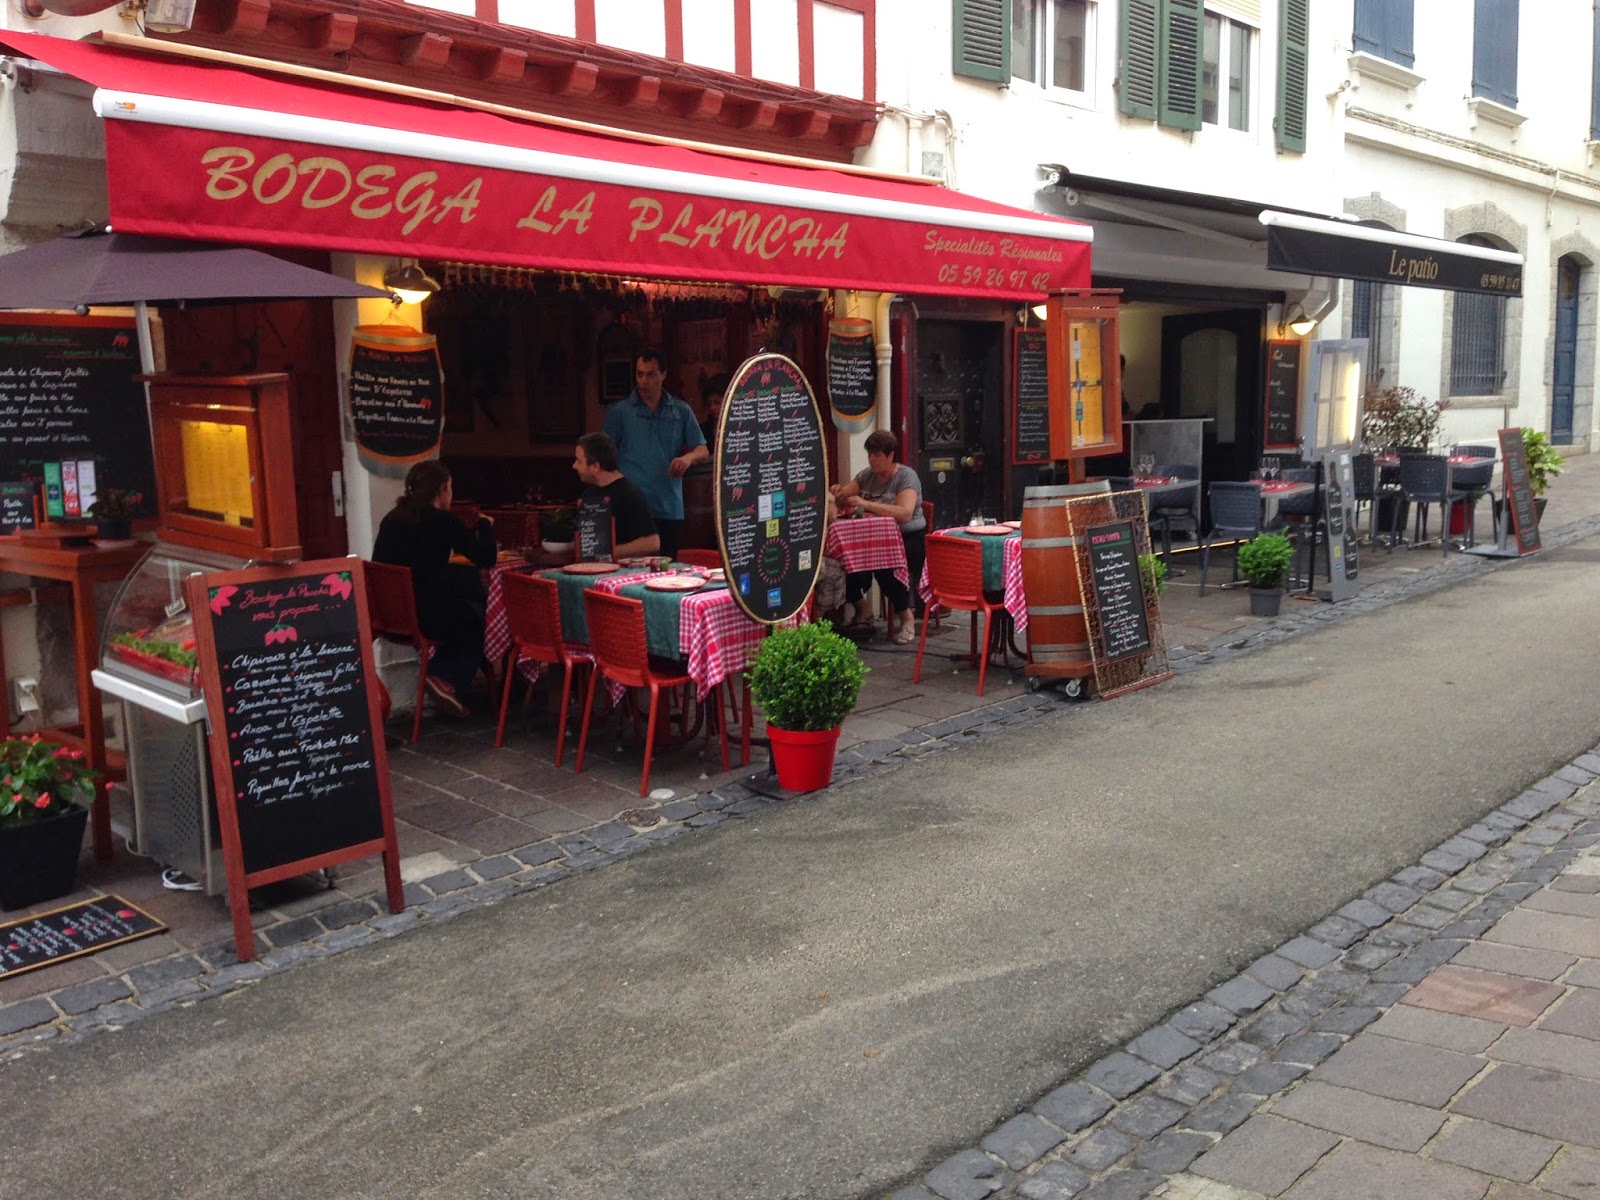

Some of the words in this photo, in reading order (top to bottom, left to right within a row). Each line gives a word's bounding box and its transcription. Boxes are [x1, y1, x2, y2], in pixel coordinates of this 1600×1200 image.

[201, 146, 482, 235] BODEGA
[516, 185, 597, 235] LA
[627, 197, 850, 260] PLANCHA
[999, 238, 1064, 265] Régionales
[938, 264, 959, 283] 05
[962, 264, 982, 286] 59
[986, 268, 1004, 287] 26
[1009, 270, 1028, 289] 97
[1032, 272, 1051, 290] 42
[1389, 249, 1407, 276] Le
[1406, 256, 1439, 285] patio
[252, 610, 276, 622] vous
[281, 675, 293, 683] de
[277, 747, 298, 757] aux
[322, 738, 337, 749] de
